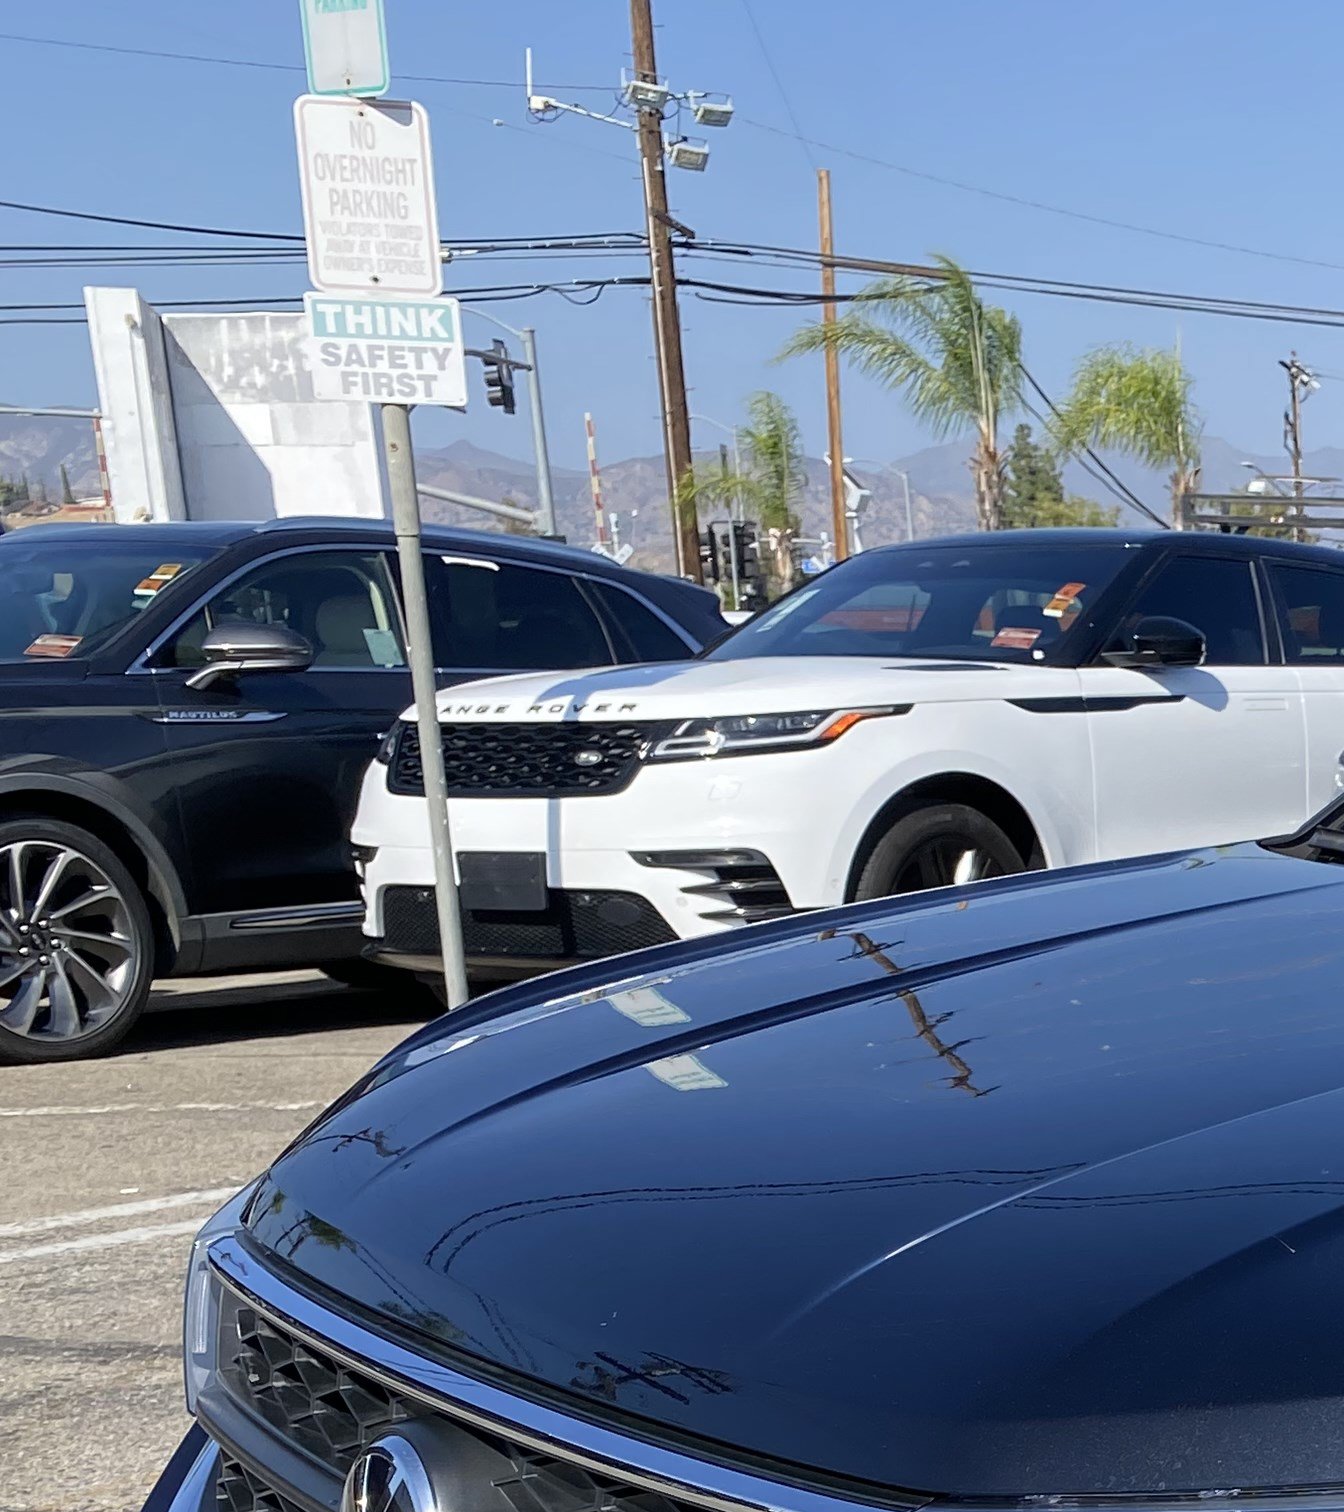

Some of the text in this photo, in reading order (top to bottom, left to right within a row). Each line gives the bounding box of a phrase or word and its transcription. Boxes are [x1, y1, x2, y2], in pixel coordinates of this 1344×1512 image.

[349, 119, 377, 150] NO
[312, 152, 418, 187] OVERNIGHT
[327, 187, 410, 220] PARKING
[315, 303, 450, 339] THINK
[319, 341, 453, 372] SAFETY
[339, 370, 439, 399] FIRST
[168, 710, 240, 719] NAUTILUS
[439, 703, 640, 715] ANGE ROVER
